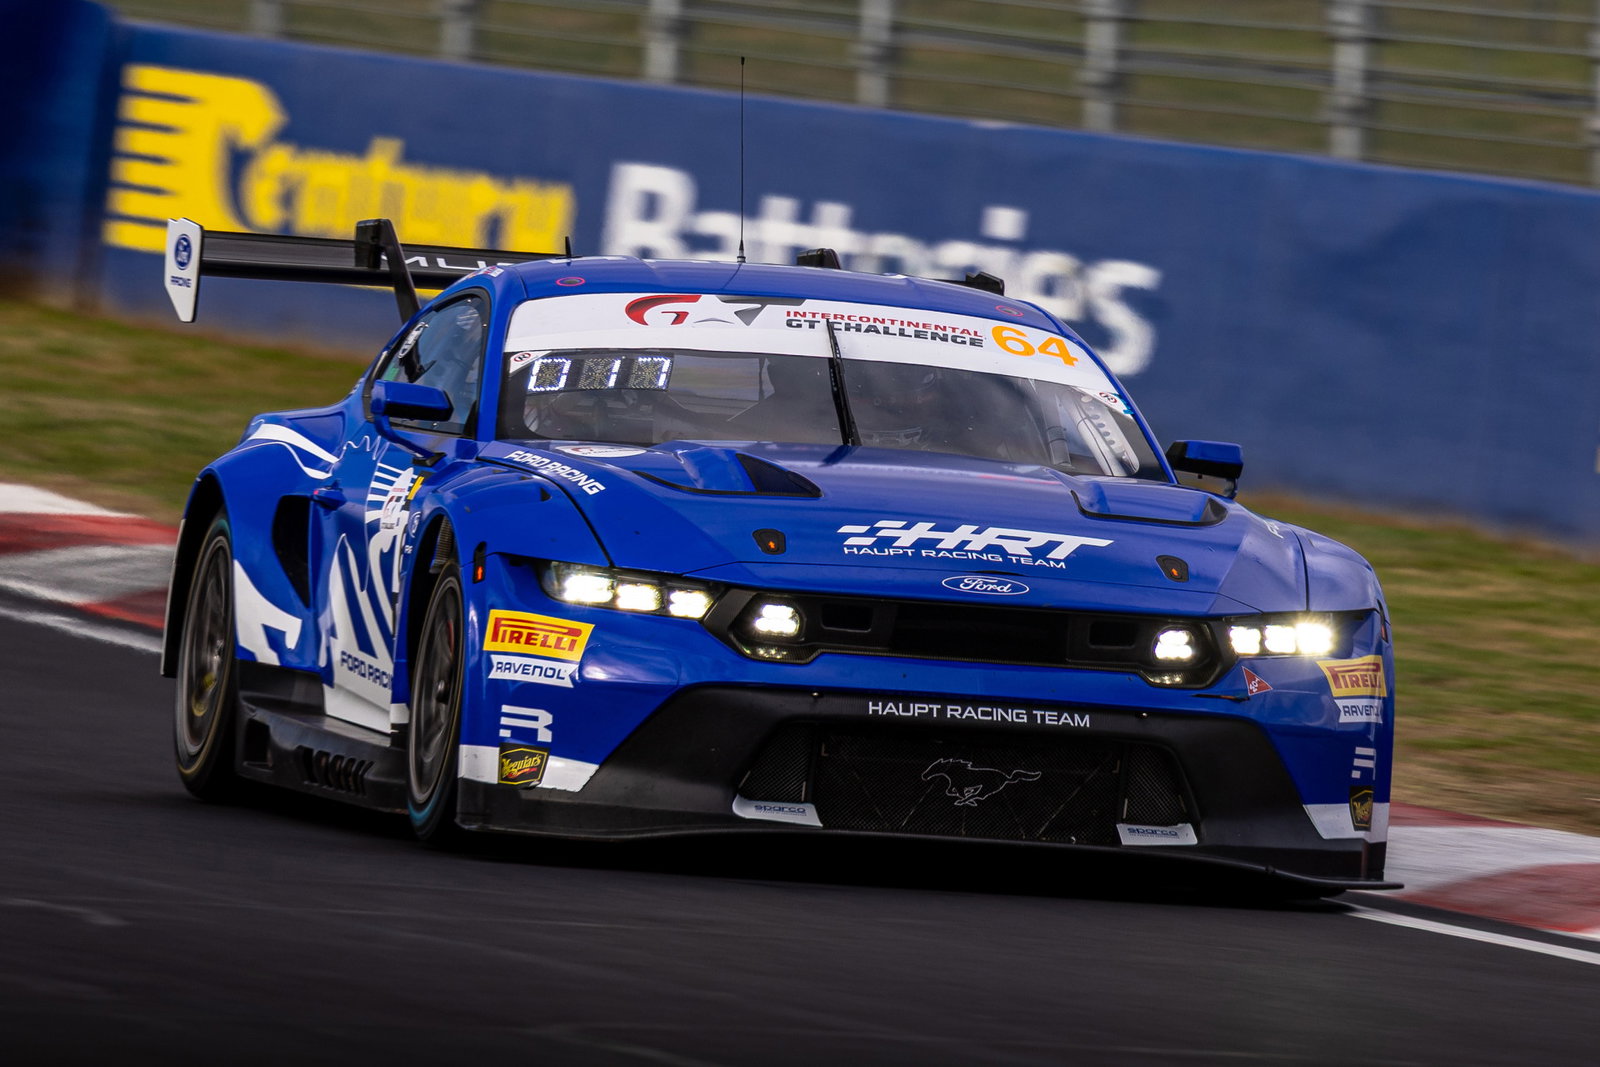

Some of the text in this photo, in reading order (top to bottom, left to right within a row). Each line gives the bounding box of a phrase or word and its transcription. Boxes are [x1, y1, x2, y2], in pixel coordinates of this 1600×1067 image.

[786, 310, 984, 338] INTERCONTINENTAL
[786, 318, 984, 348] GT CHALLENGE
[991, 325, 1079, 367] 64
[528, 357, 671, 391] 017
[504, 450, 547, 468] FORD
[541, 461, 606, 496] RACING
[843, 547, 1067, 569] HAUPT RACING TEAM
[959, 576, 1012, 593] Ford
[491, 617, 583, 652] PIRELLI
[340, 650, 392, 689] FORD RACI
[496, 661, 565, 680] RAVENOL
[868, 701, 1090, 728] HAUPT RACING TEAM
[754, 804, 806, 814] sparco
[1127, 827, 1178, 837] sparco
